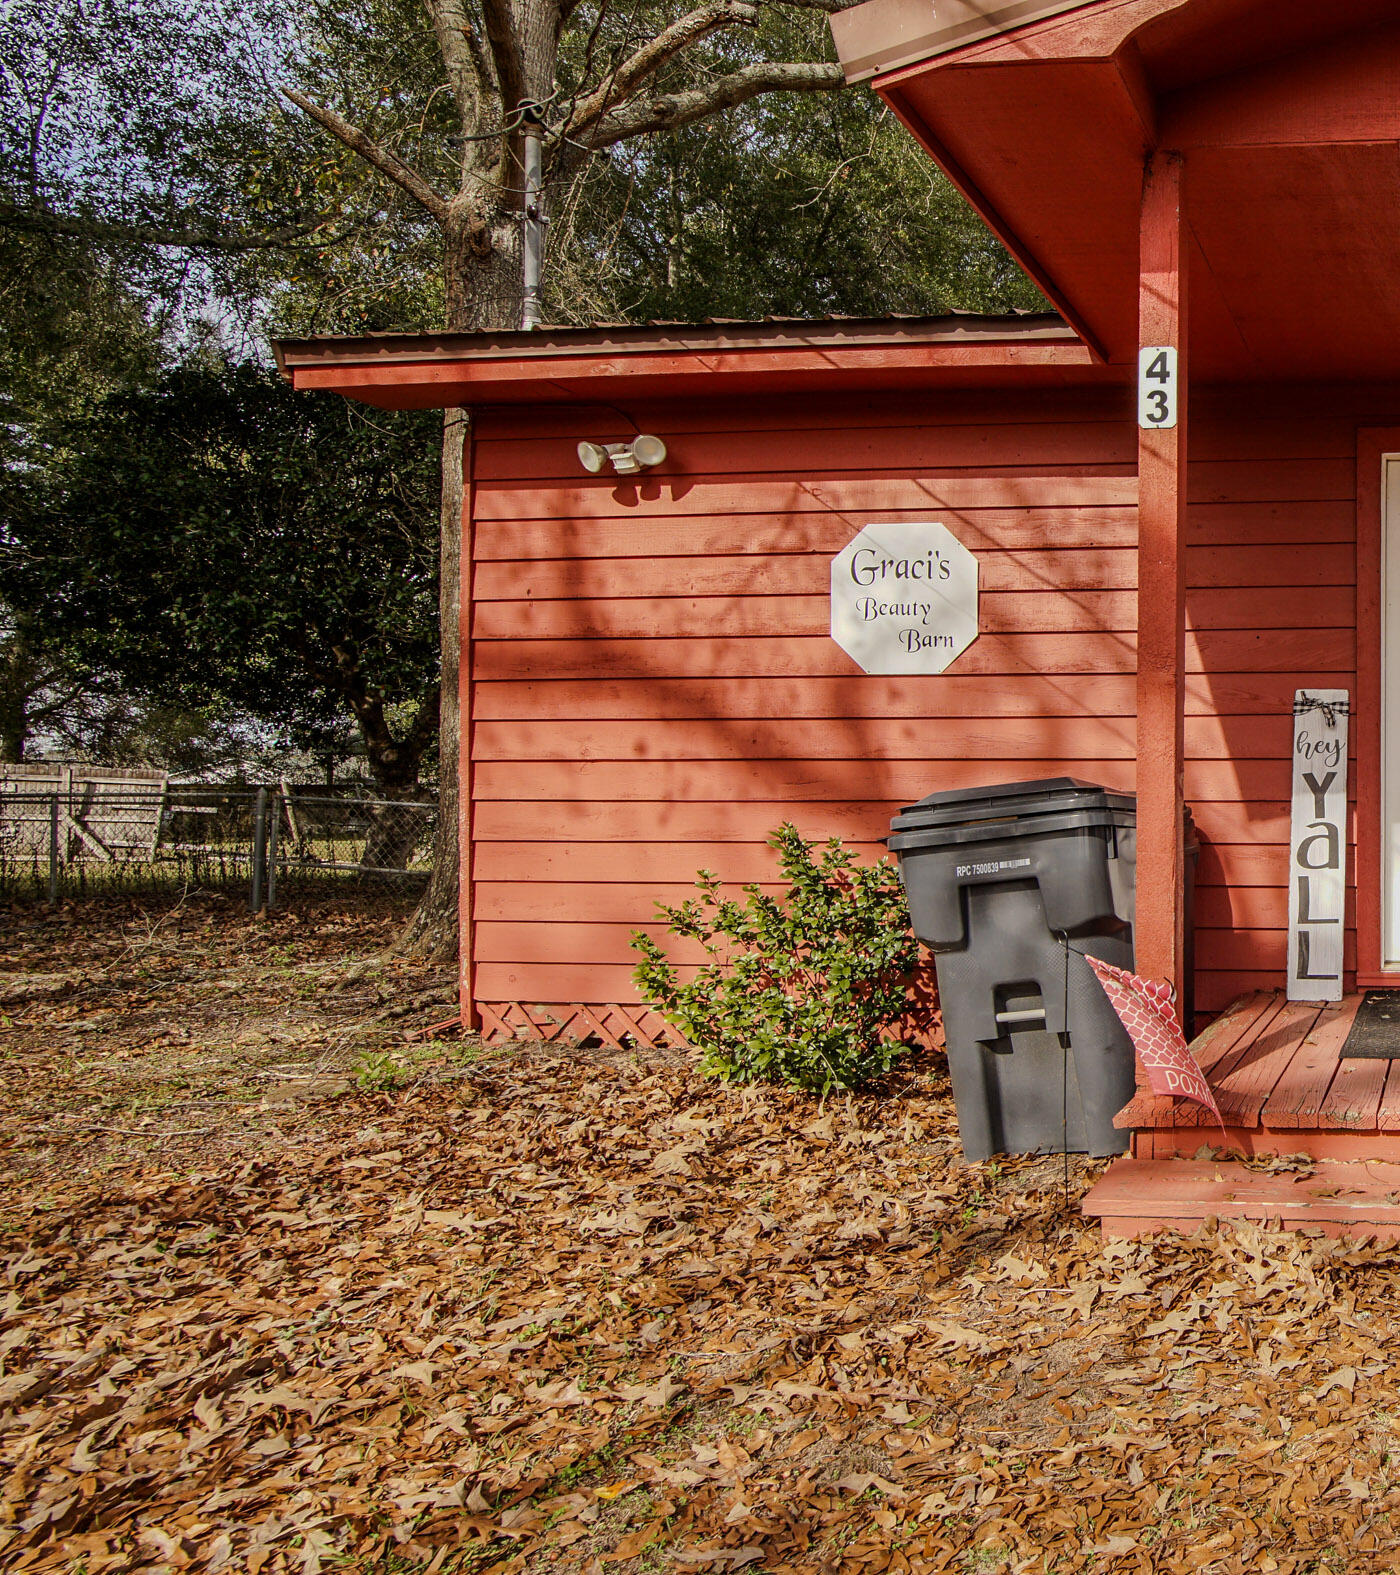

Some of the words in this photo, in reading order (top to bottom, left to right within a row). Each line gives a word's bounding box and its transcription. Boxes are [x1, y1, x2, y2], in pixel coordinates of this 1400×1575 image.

[851, 549, 950, 586] Graci's
[856, 597, 931, 625] Beauty
[899, 629, 953, 653] Barn
[1296, 730, 1345, 767] hey
[956, 865, 971, 877] RPC
[972, 861, 999, 875] 7500839
